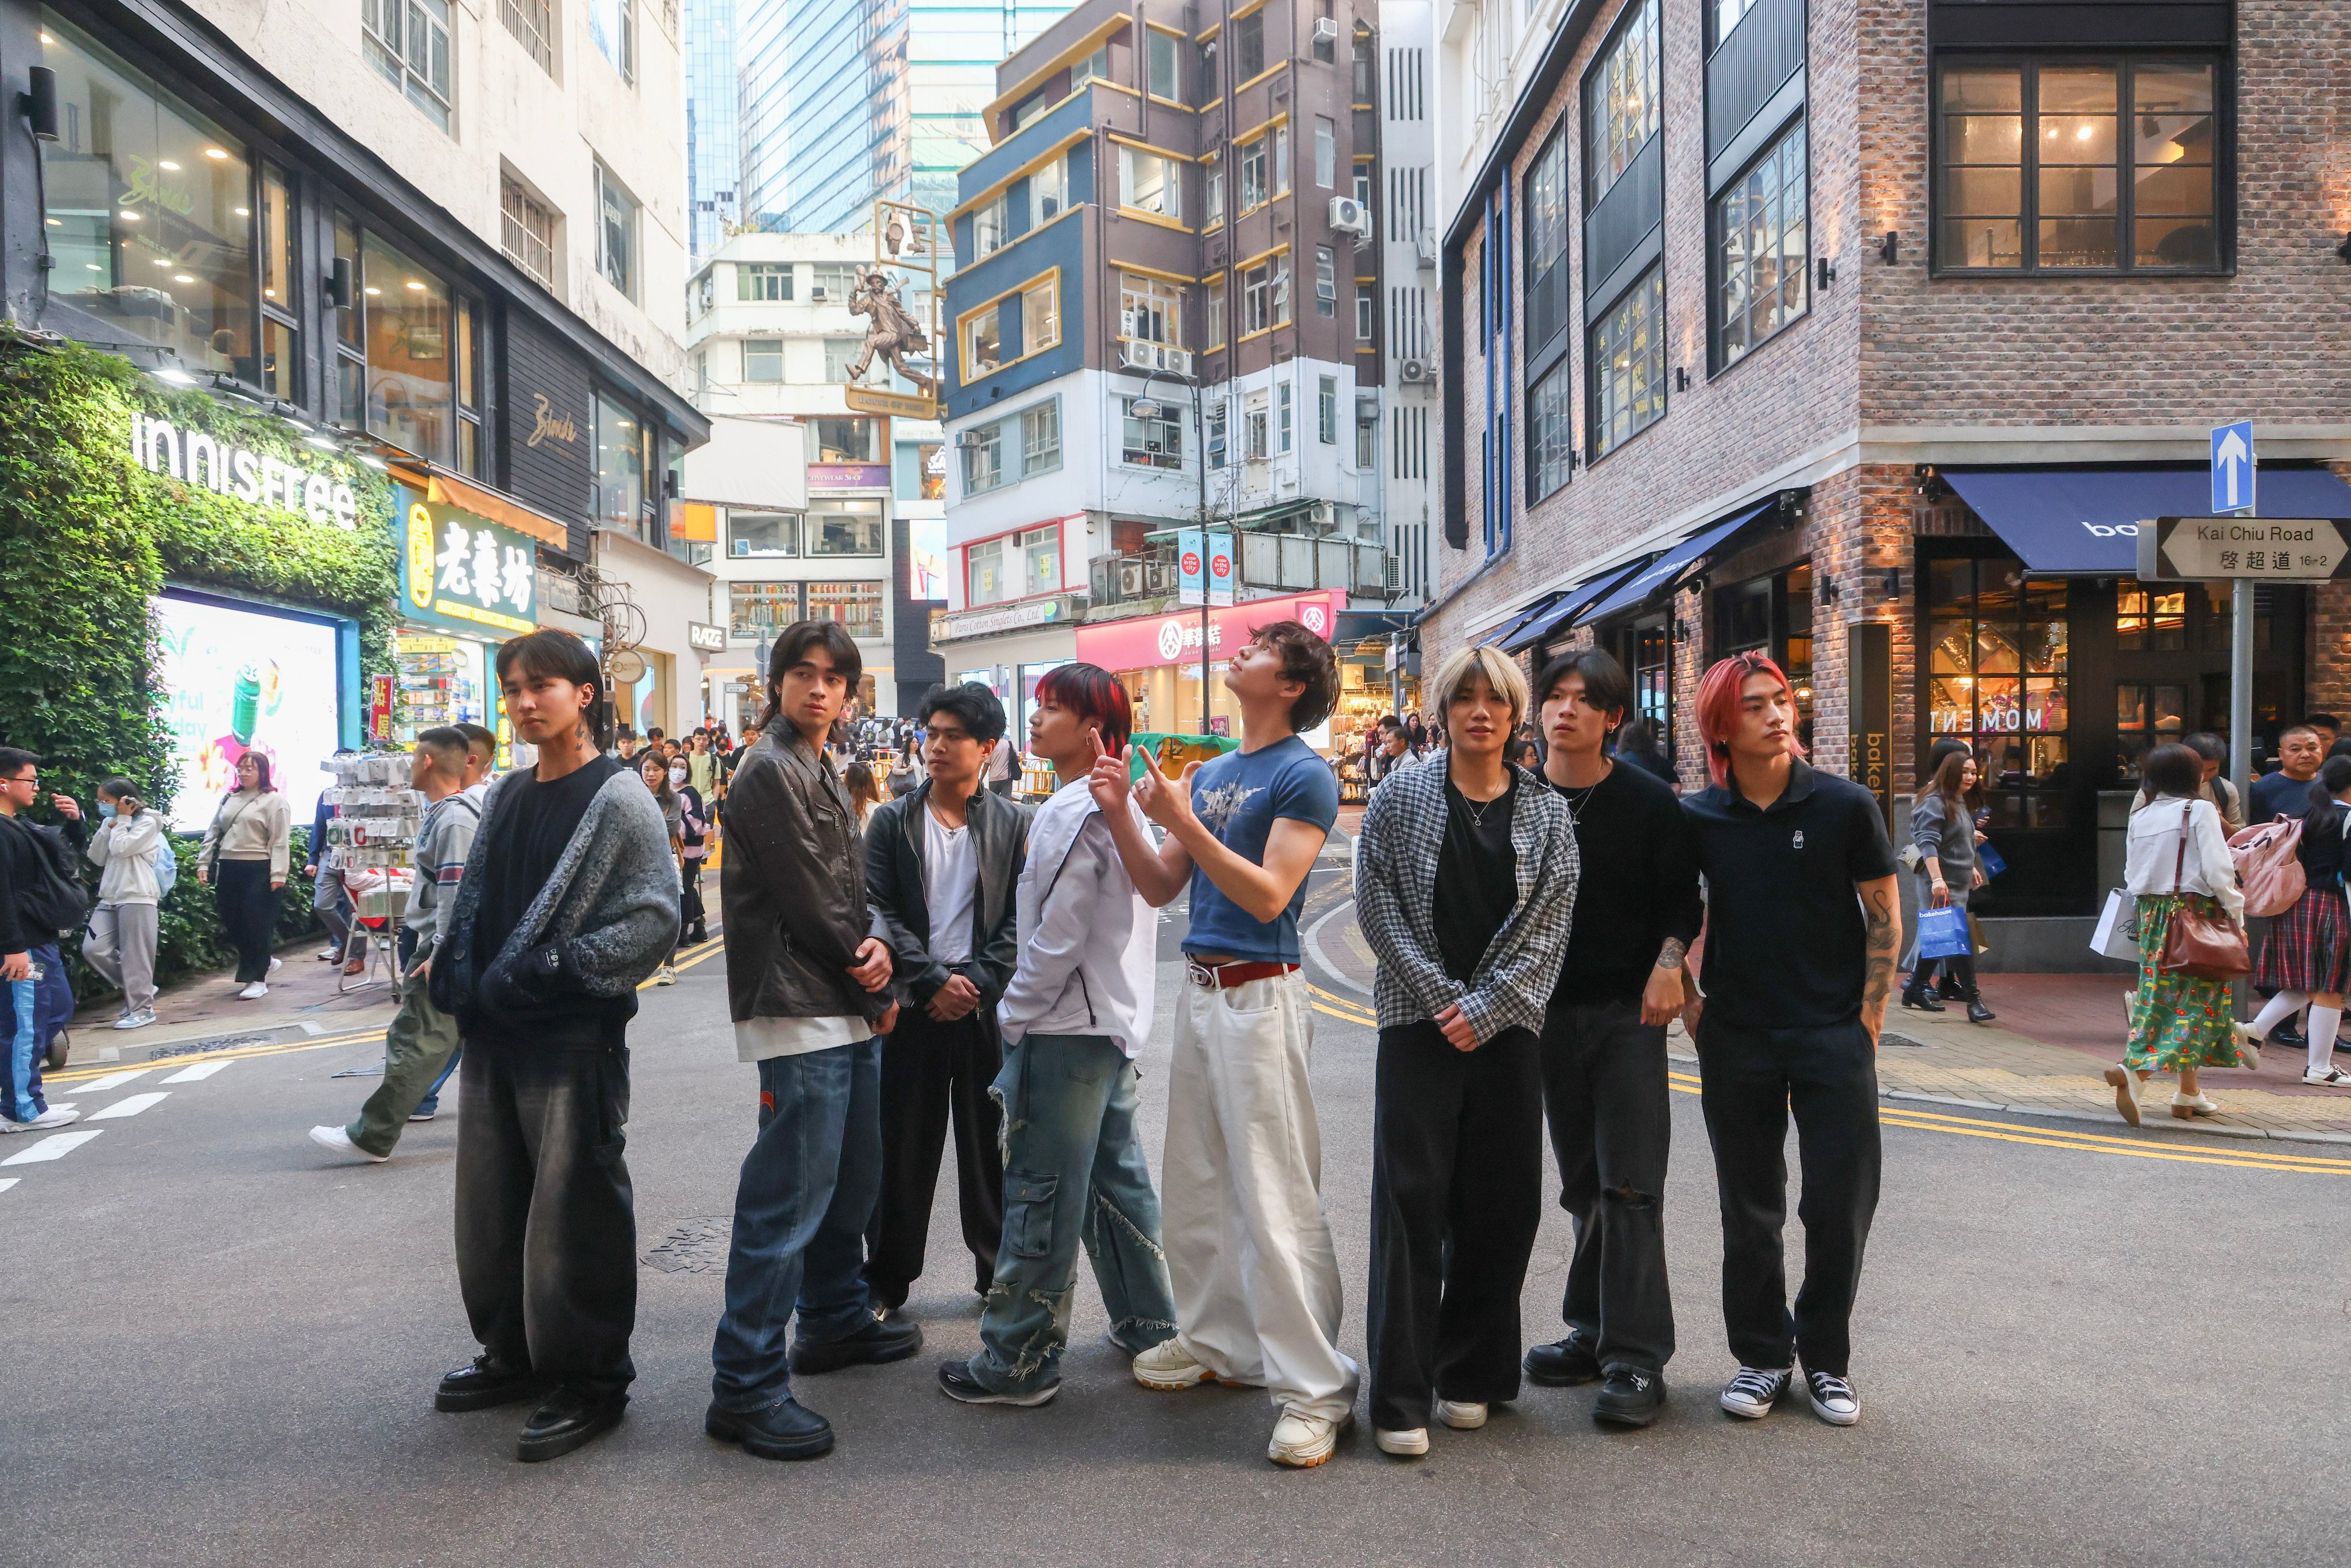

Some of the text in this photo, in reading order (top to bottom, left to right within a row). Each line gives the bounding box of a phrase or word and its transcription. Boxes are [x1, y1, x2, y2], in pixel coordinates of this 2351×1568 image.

[2197, 525, 2314, 541] Kai Chiu Road
[1186, 565, 1196, 573] city
[1217, 567, 1227, 576] city
[955, 623, 969, 633] Paris
[969, 616, 991, 631] Cotton
[990, 612, 1012, 629] Singlets
[1027, 606, 1040, 620] Ltd.
[1919, 909, 1952, 918] bakehouse
